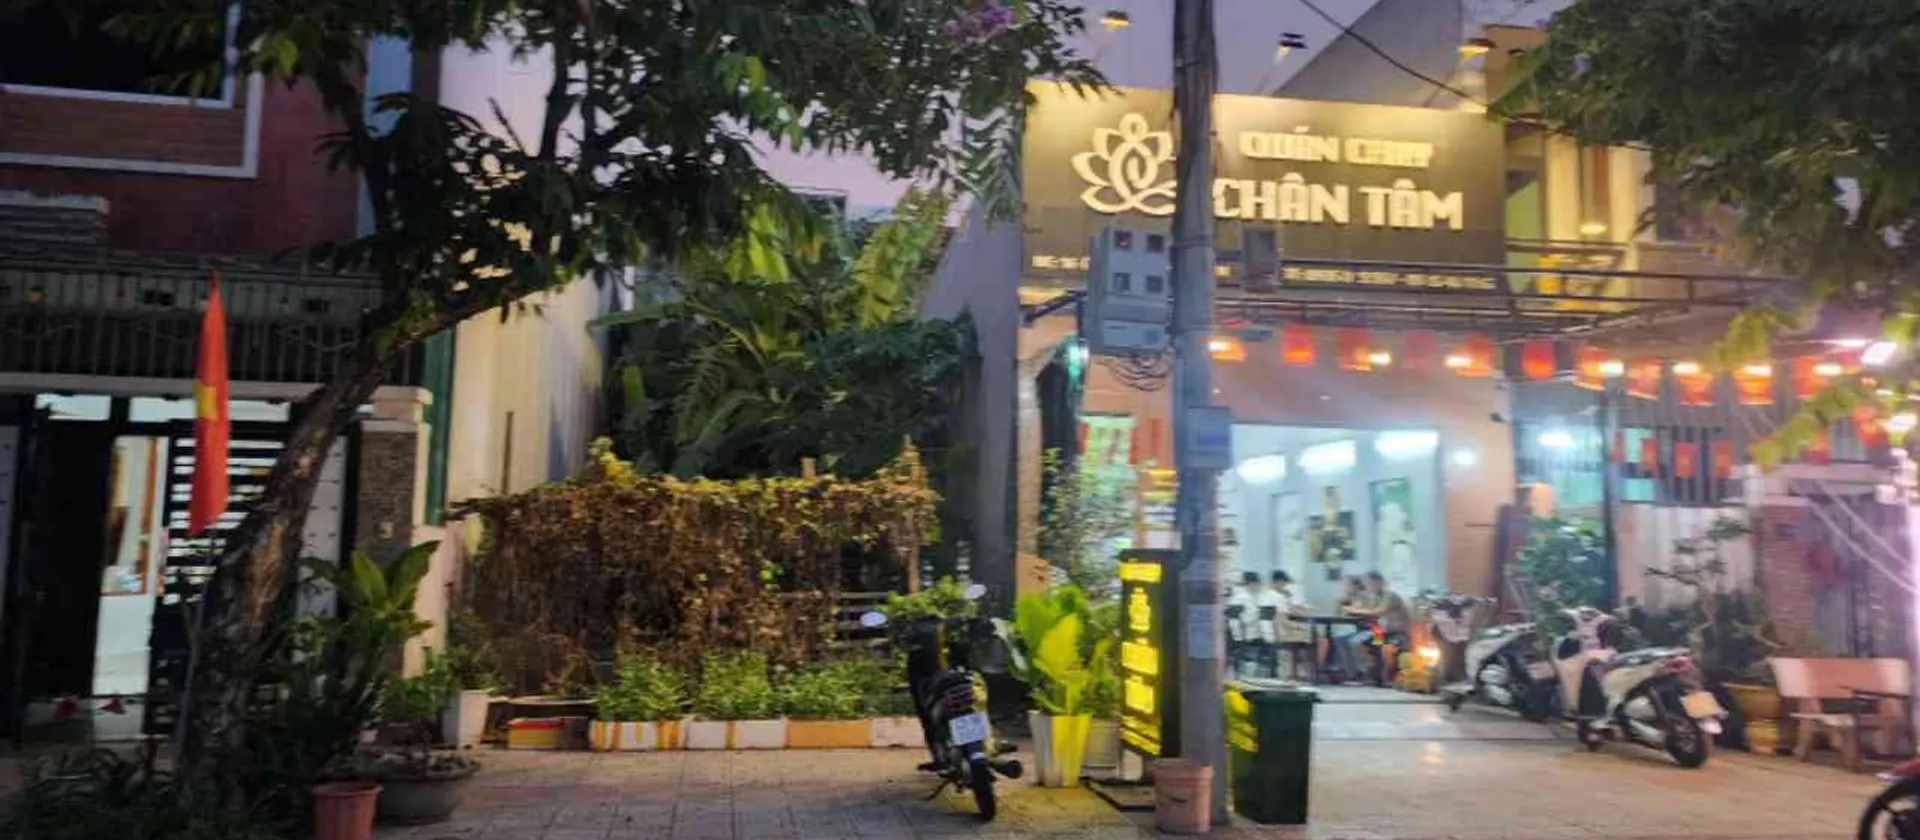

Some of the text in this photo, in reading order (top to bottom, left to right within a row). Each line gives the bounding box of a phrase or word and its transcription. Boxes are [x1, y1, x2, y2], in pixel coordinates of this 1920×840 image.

[1239, 126, 1340, 162] QUÁN
[1213, 172, 1464, 229] CHÂN TÂM
